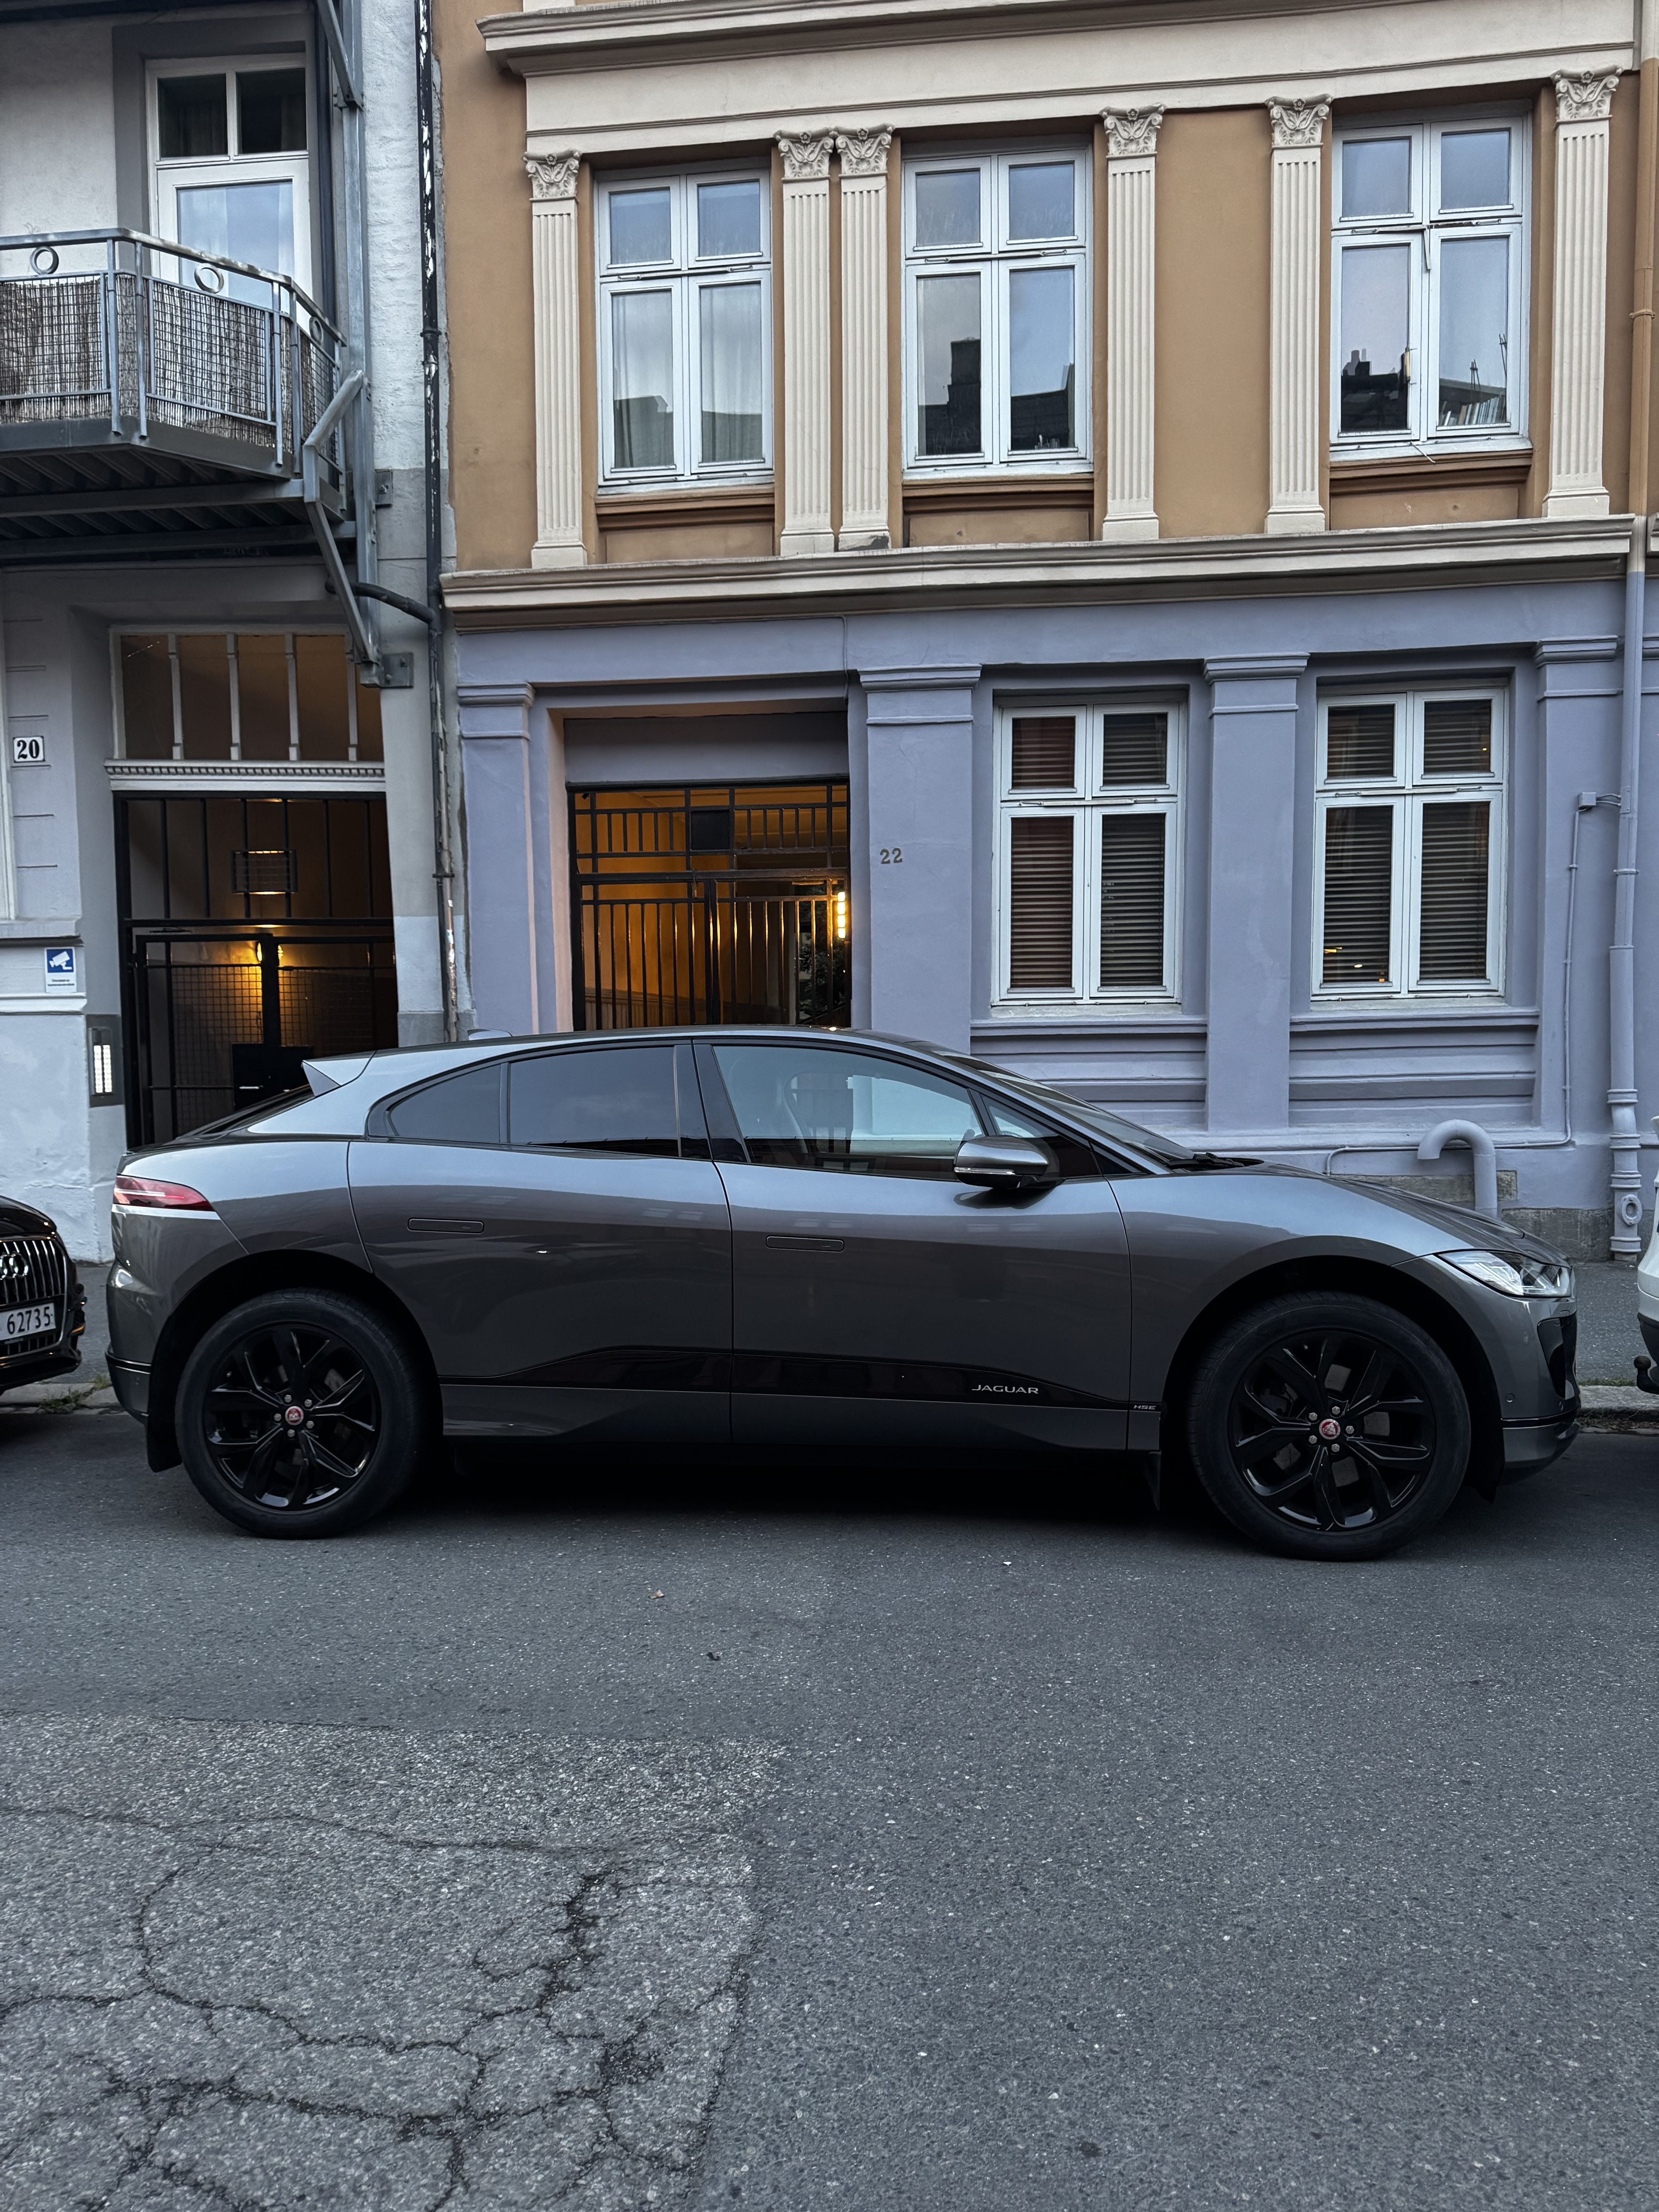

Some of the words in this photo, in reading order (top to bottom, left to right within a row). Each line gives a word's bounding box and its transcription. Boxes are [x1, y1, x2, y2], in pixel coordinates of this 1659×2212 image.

[17, 739, 40, 759] 20
[879, 847, 903, 864] 22
[7, 1306, 50, 1334] 62735
[972, 1384, 1038, 1394] JAGUAR
